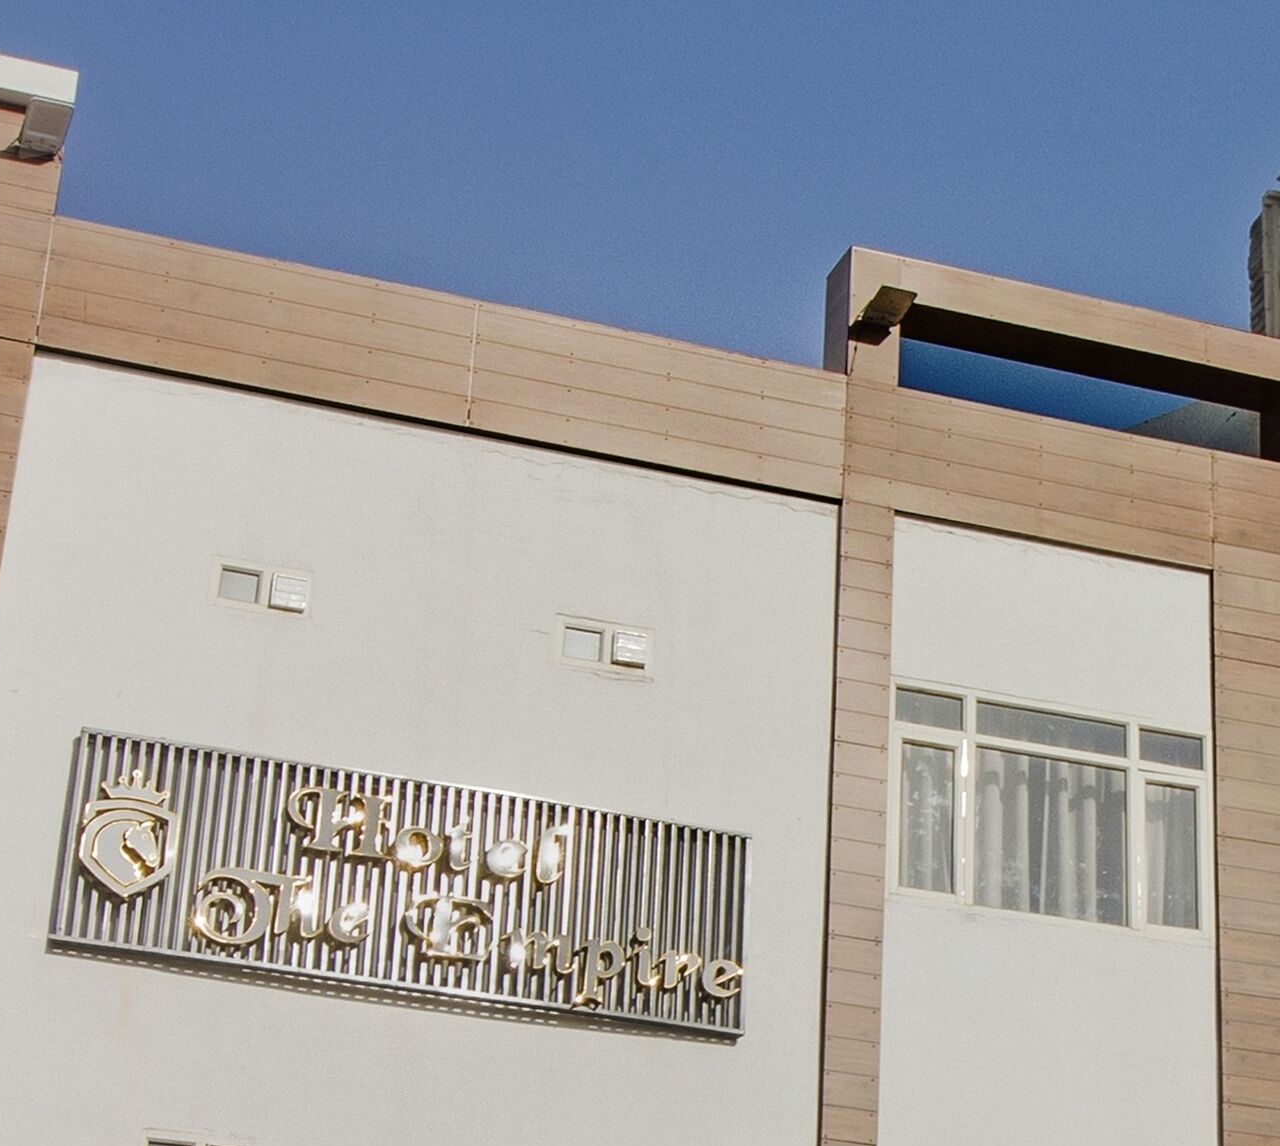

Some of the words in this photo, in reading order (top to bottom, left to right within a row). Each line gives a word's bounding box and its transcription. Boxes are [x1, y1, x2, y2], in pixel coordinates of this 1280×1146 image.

[285, 785, 573, 885] Hotel
[189, 868, 372, 945] The
[405, 893, 746, 1010] Empire
